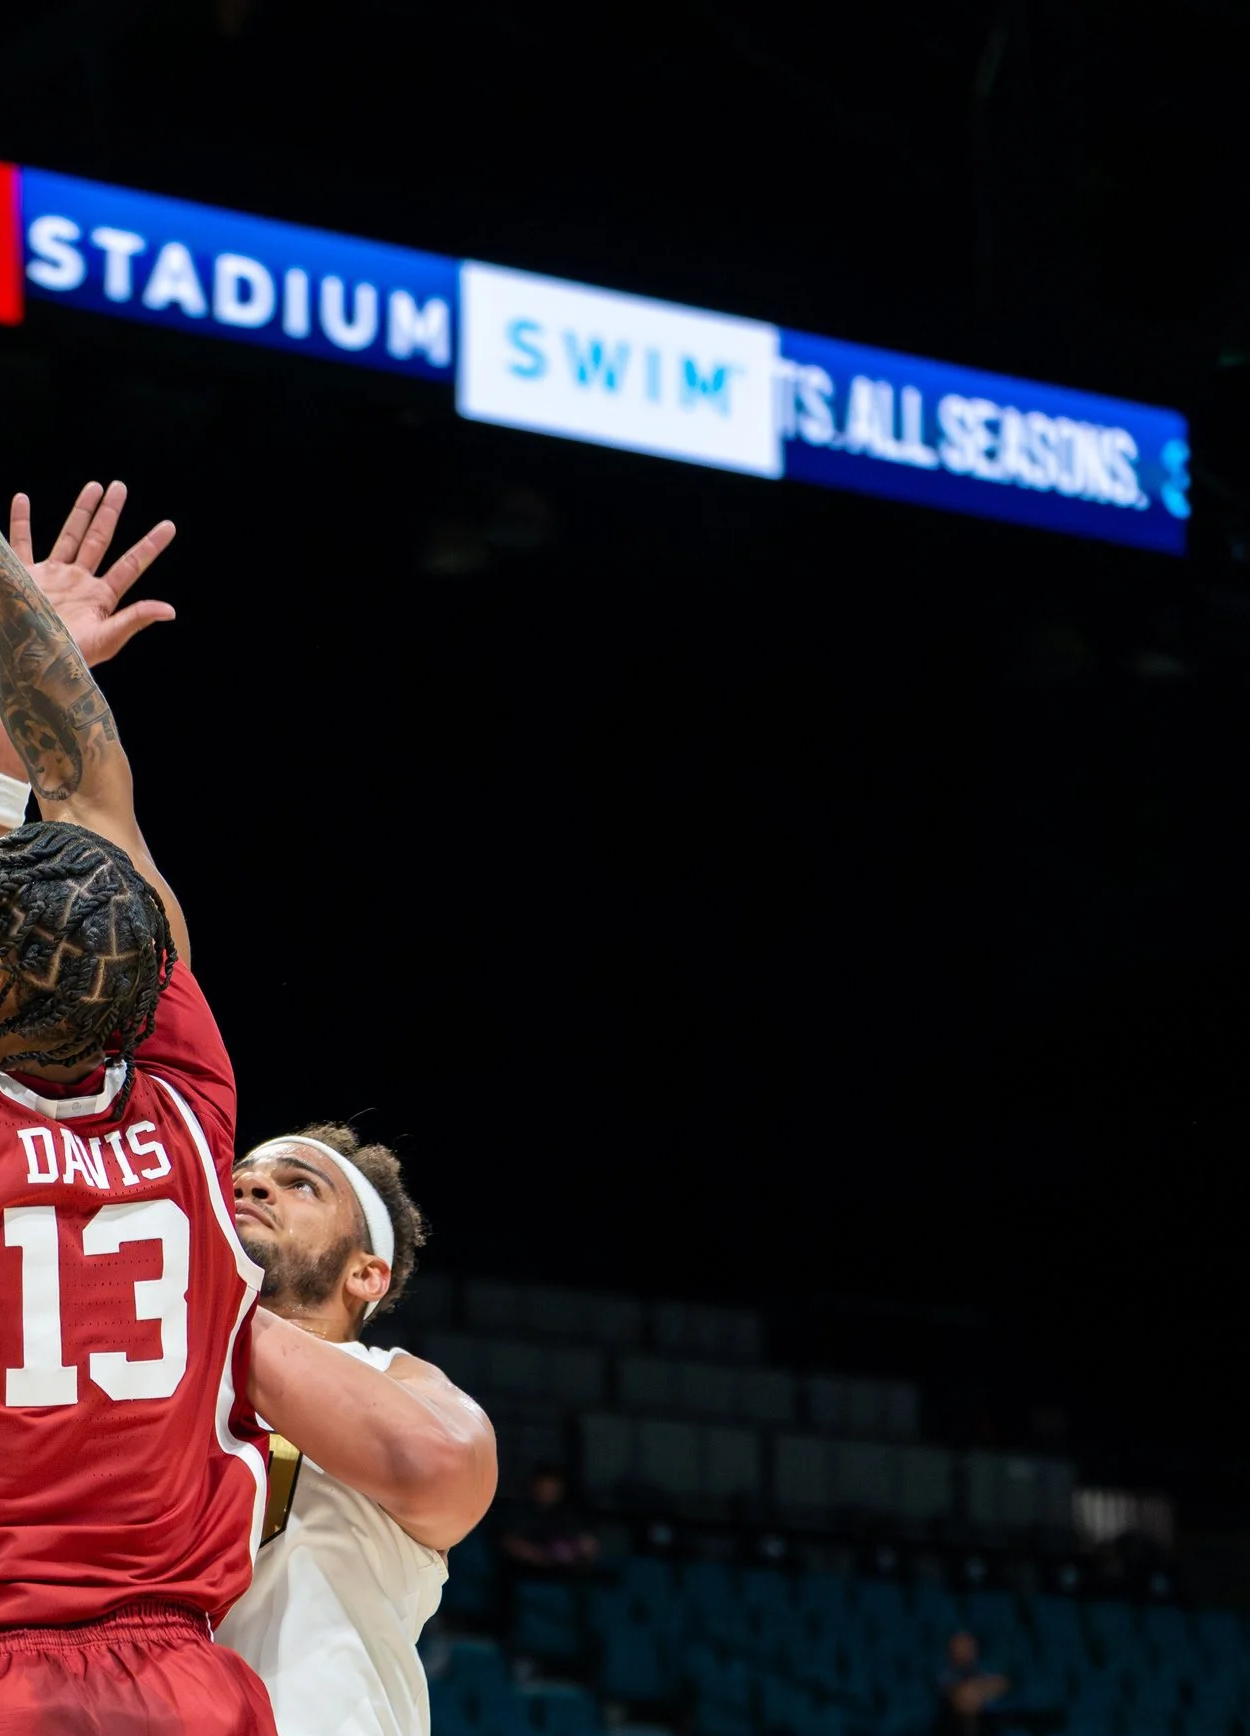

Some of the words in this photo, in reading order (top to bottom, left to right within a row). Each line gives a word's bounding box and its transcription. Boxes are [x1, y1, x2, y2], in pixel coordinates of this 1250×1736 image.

[25, 215, 451, 368] STADIUM
[506, 319, 737, 420] SWIM
[937, 393, 1150, 511] SEASONS.
[17, 1120, 172, 1190] DAVIS
[3, 1199, 191, 1407] 13
